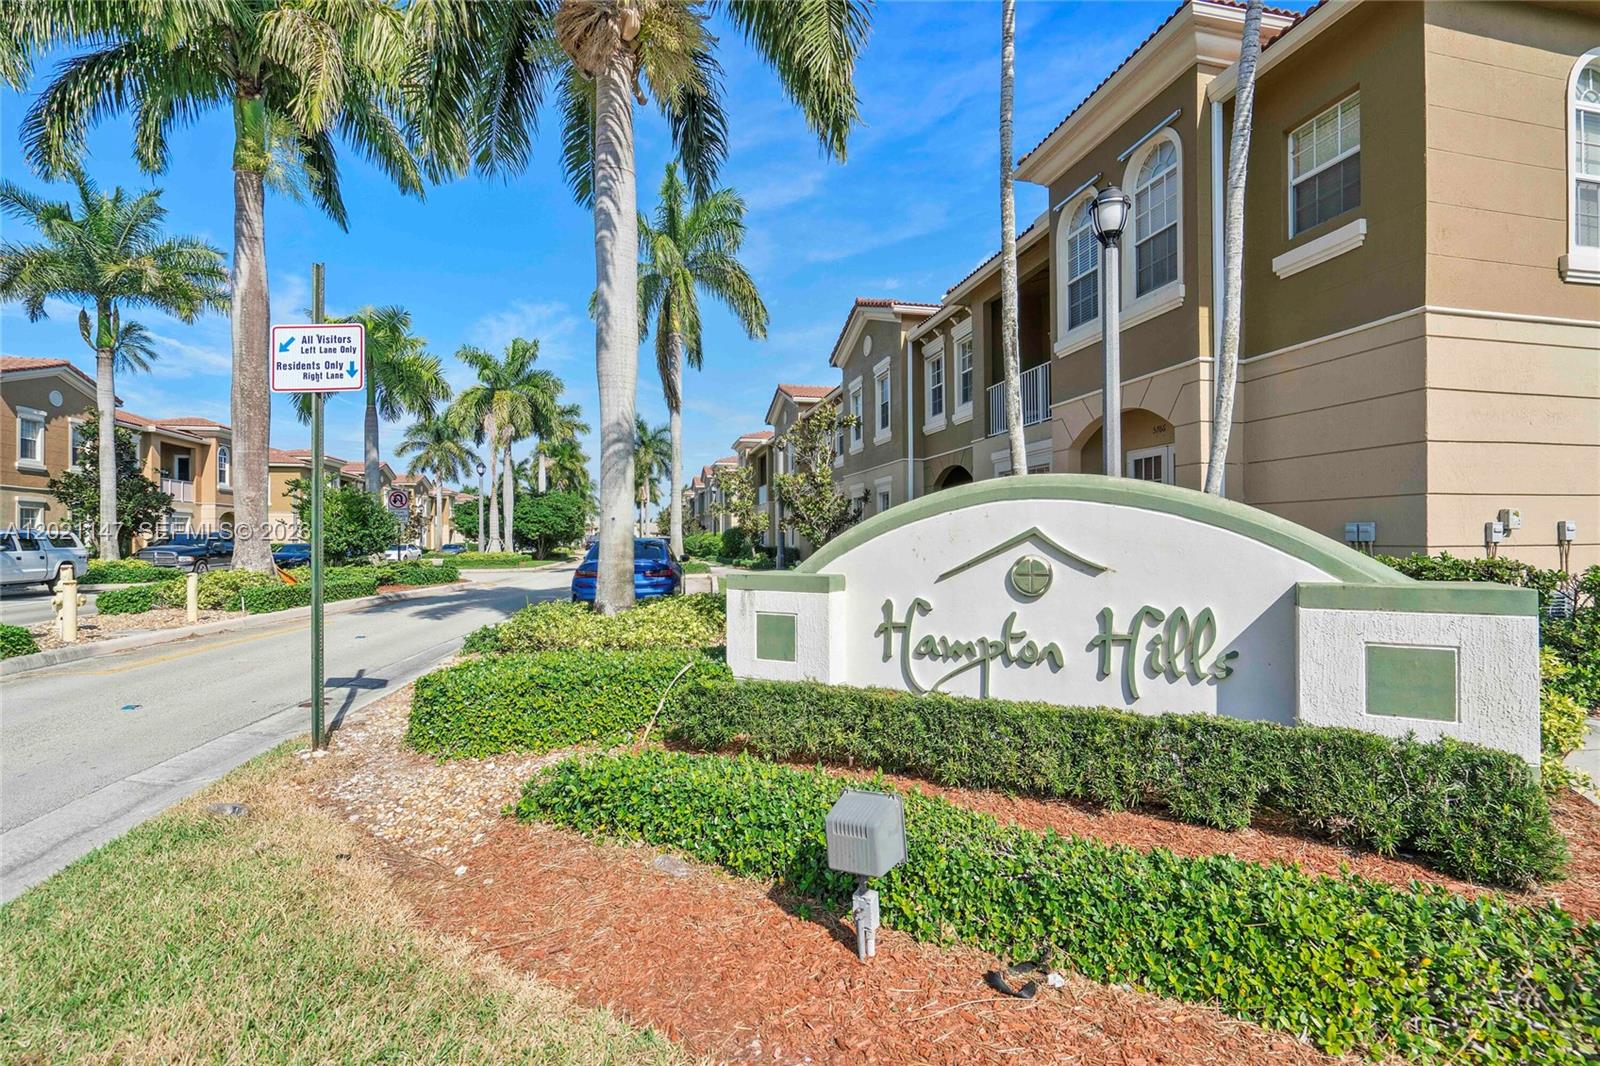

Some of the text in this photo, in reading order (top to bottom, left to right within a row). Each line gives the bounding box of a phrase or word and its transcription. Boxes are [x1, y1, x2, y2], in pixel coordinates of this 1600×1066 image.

[301, 334, 352, 344] All Visitors
[300, 345, 357, 354] Left Lane Only
[276, 360, 344, 370] Residents Only
[302, 371, 344, 382] Right Lane
[874, 597, 1239, 700] Hampton Hills
